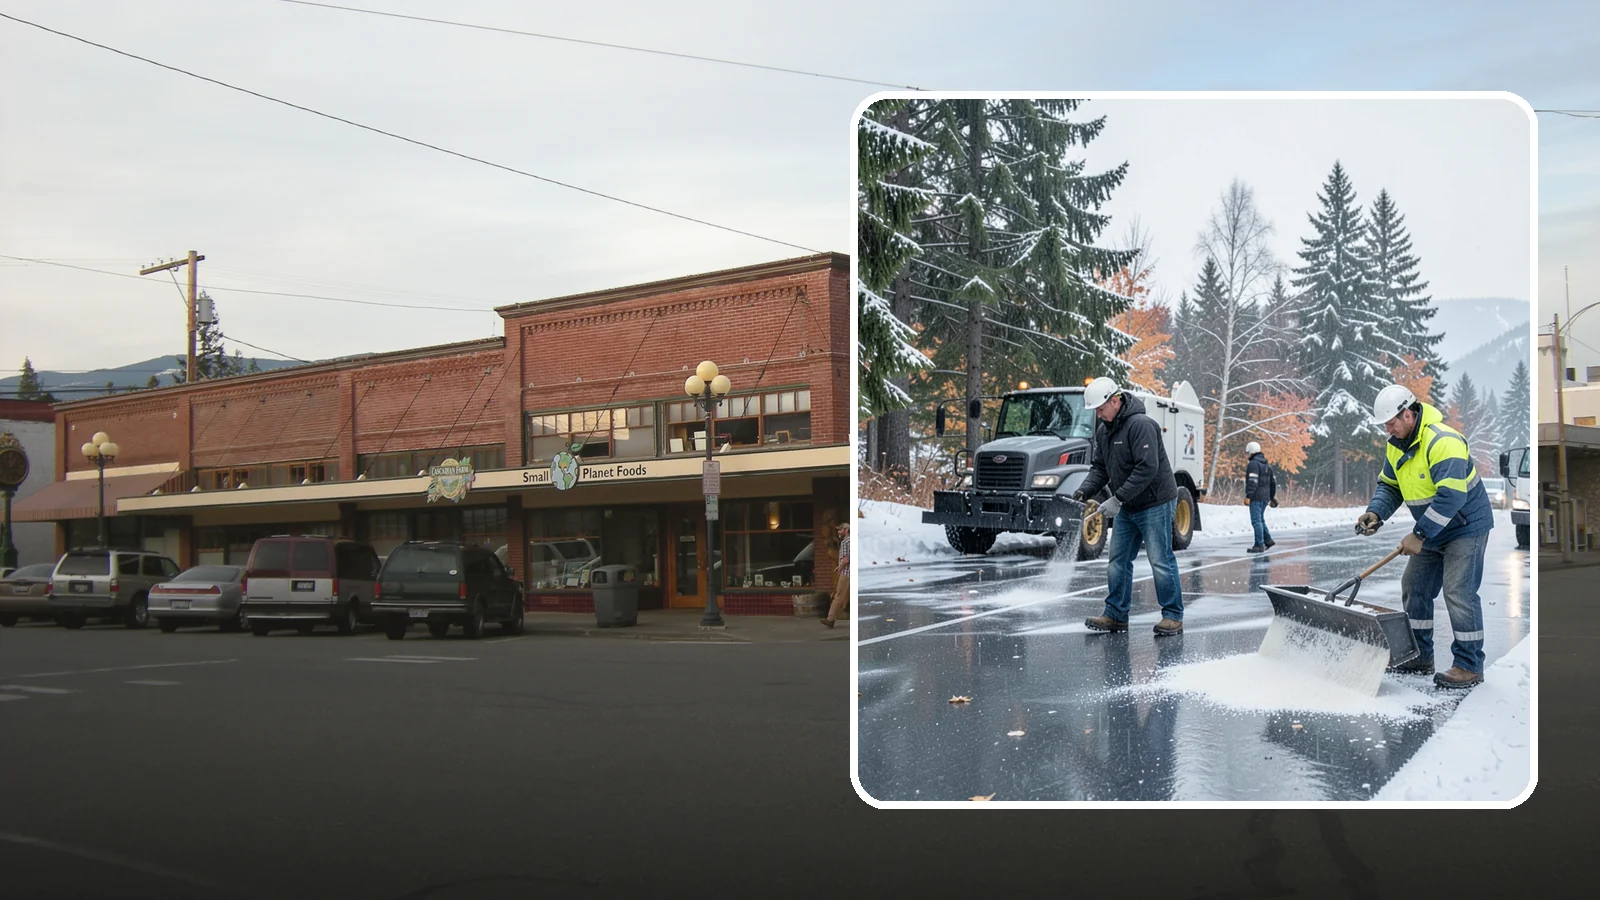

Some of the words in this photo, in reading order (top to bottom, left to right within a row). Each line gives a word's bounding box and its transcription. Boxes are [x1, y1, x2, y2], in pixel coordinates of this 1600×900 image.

[523, 471, 548, 482] Small
[583, 467, 614, 479] Planet
[616, 464, 646, 476] Foods
